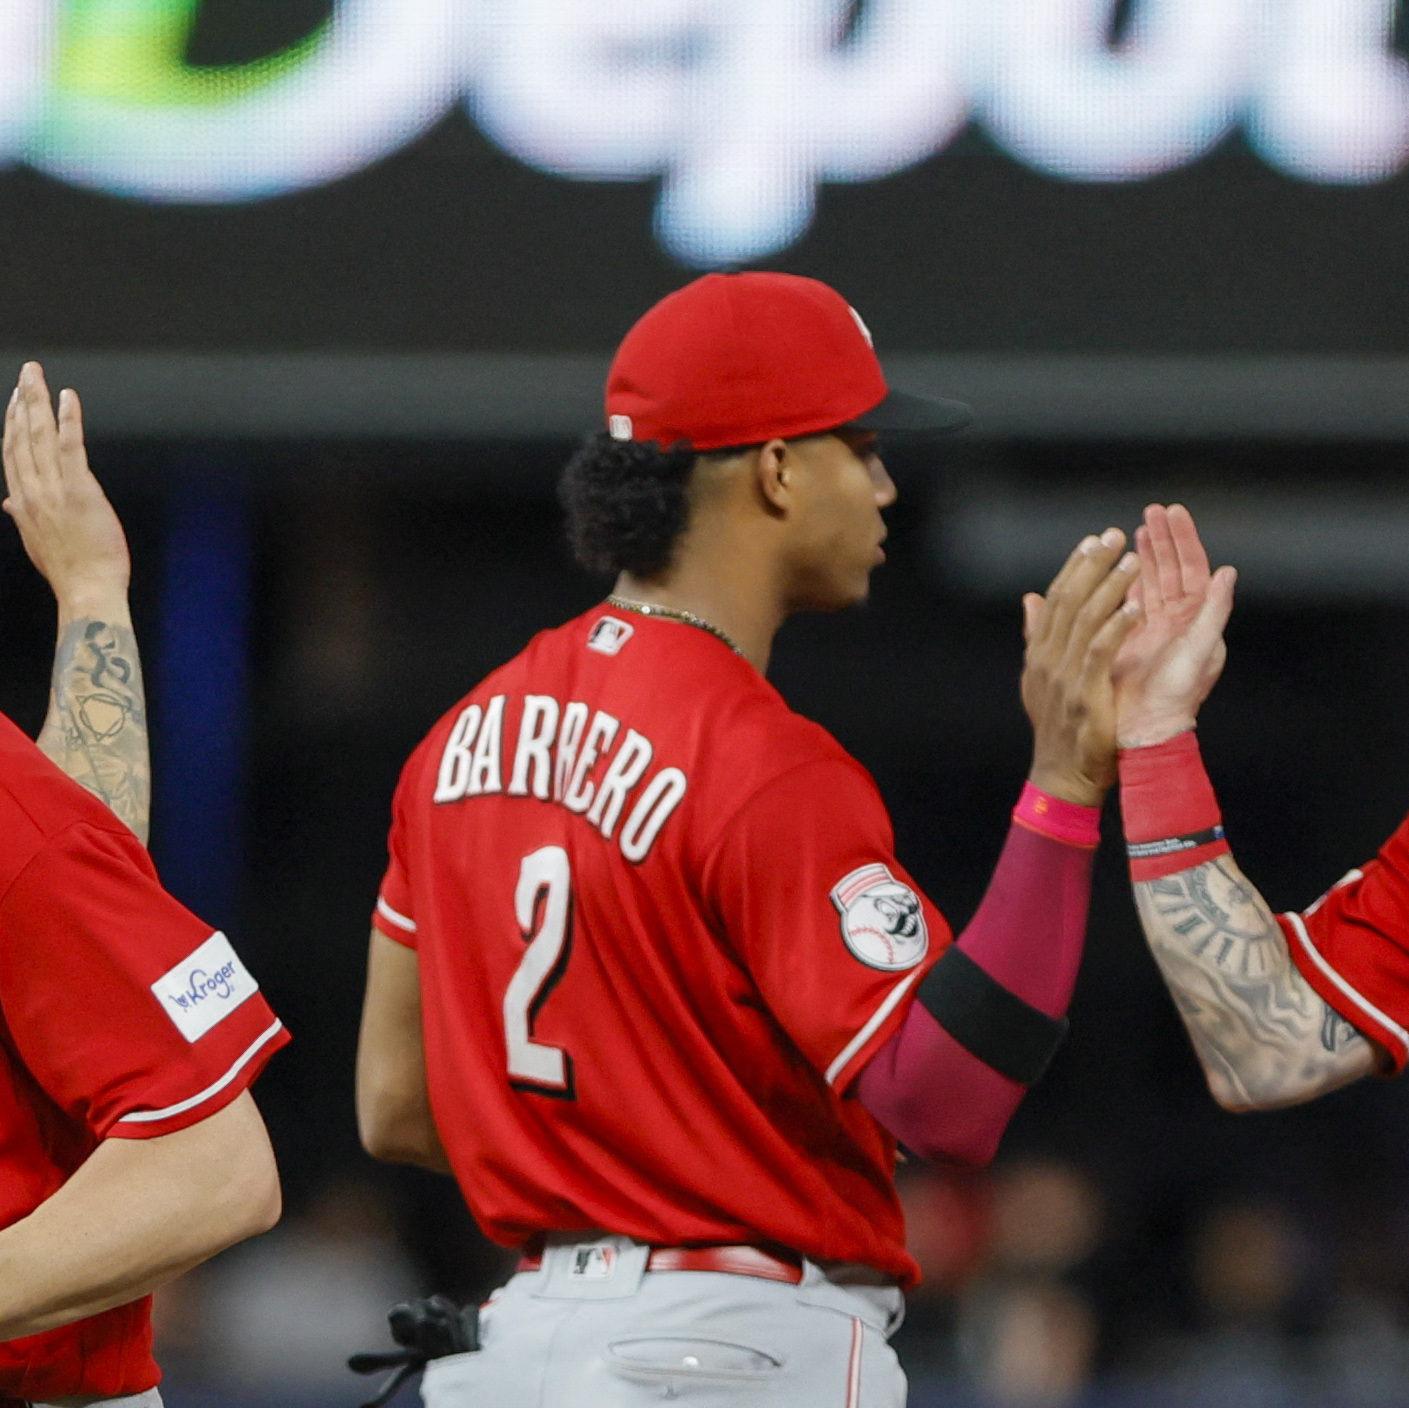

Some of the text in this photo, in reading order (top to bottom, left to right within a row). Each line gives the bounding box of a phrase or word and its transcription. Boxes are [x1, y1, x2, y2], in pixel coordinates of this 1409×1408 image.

[434, 694, 688, 865] BARRERO
[185, 960, 236, 1005] Kroger
[503, 846, 577, 1100] 2
